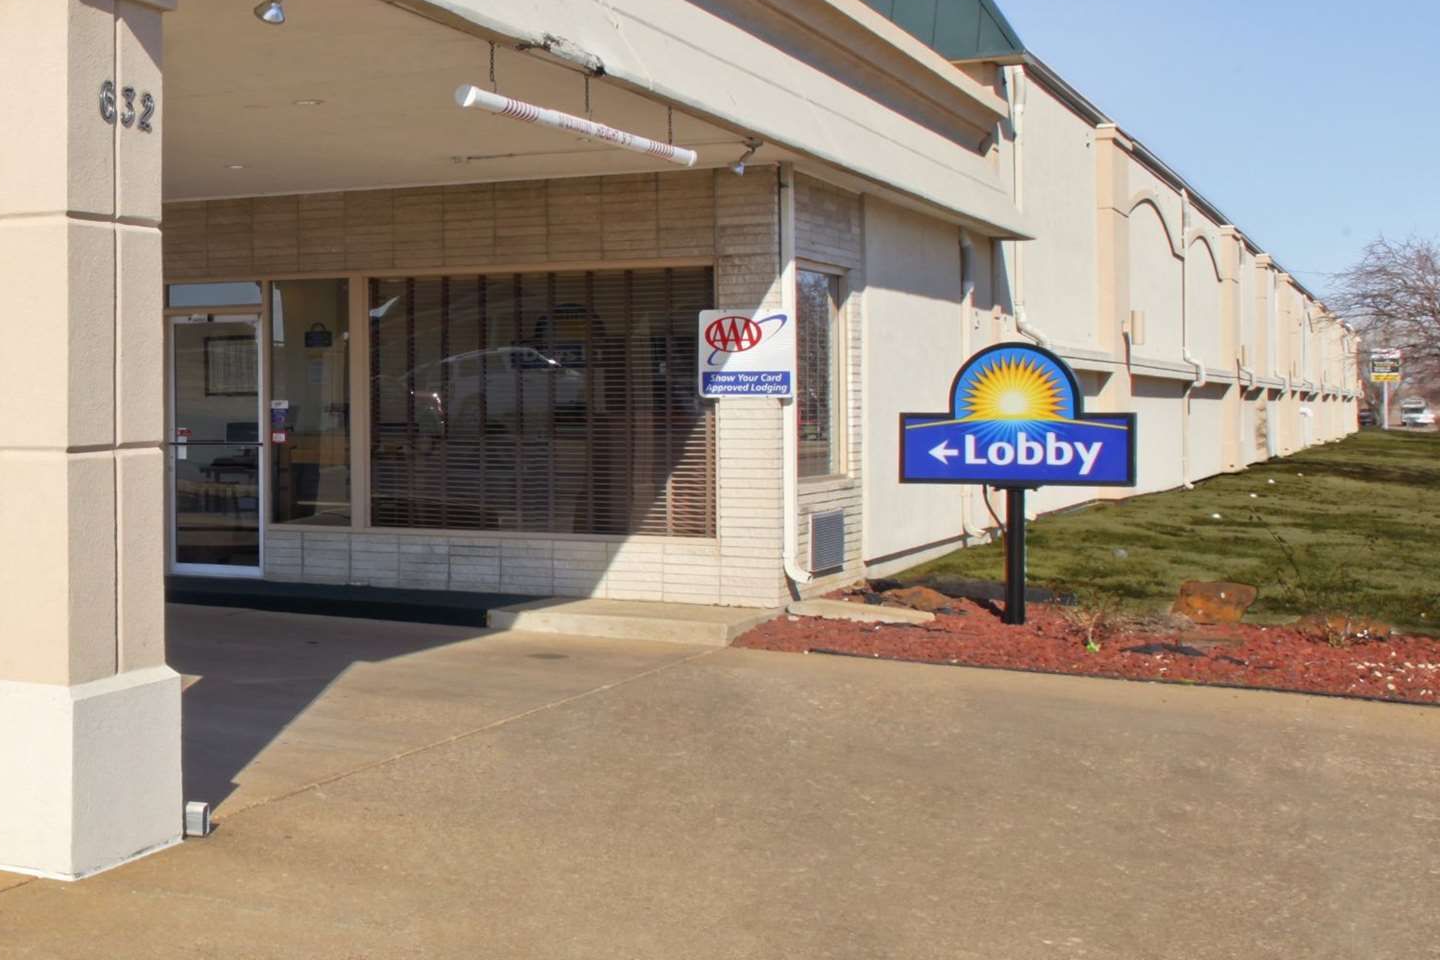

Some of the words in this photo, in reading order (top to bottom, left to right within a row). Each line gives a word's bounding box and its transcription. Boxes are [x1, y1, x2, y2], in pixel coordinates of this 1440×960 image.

[99, 80, 155, 134] 632
[710, 316, 759, 352] AAA
[706, 383, 750, 393] Approved
[750, 383, 788, 394] Lodging
[710, 373, 736, 383] Show
[737, 373, 759, 383] Your
[760, 373, 783, 383] Card
[964, 431, 1104, 476] Lobby
